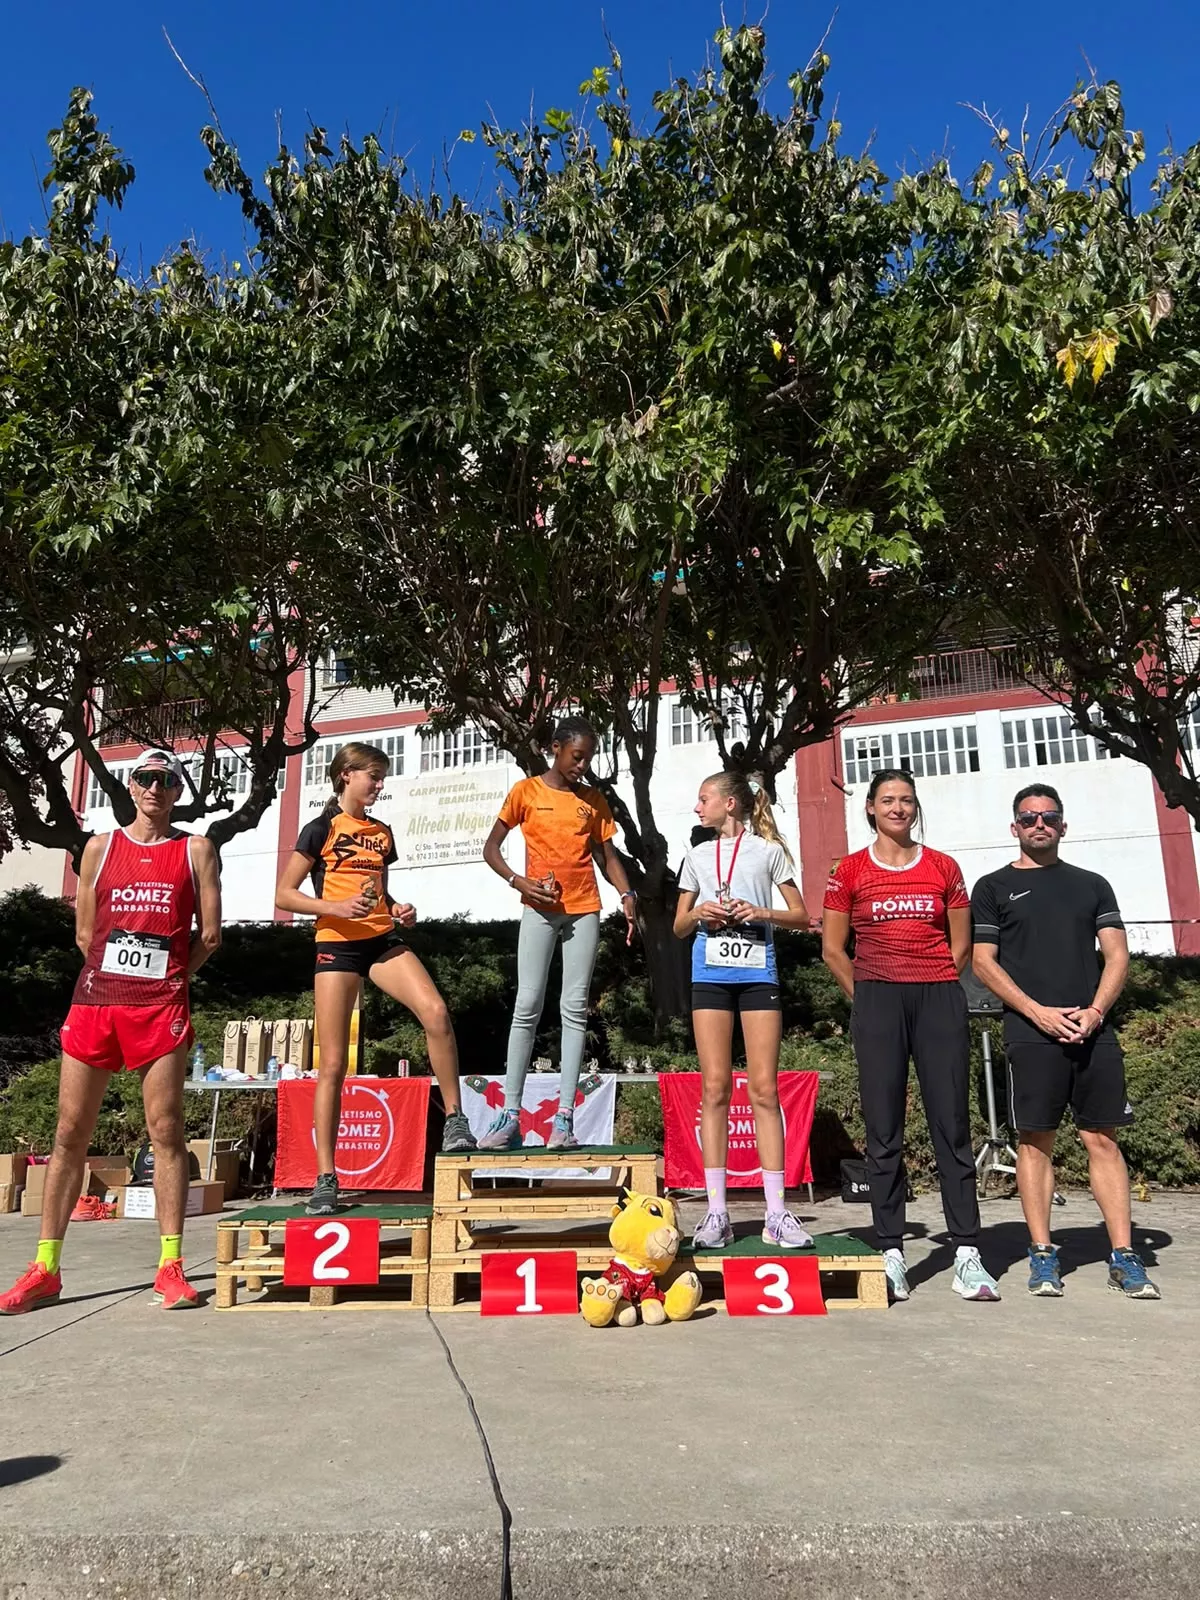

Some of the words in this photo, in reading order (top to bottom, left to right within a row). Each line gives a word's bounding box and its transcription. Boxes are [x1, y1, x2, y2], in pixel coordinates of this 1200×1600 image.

[409, 782, 476, 797] CARPINTERIA
[438, 790, 504, 805] EBANISTERIA
[406, 813, 450, 837] Alfredo
[434, 841, 451, 849] Teresa
[473, 838, 480, 846] 15
[134, 881, 174, 890] ATLETISMO
[111, 885, 173, 904] PÓMEZ
[110, 904, 170, 914] BARBASTRO
[871, 897, 935, 913] PÓMEZ
[719, 942, 753, 959] 307
[117, 949, 152, 969] 001
[340, 1110, 383, 1119] LETISMO
[337, 1120, 382, 1137] ÓMEZ
[336, 1141, 381, 1150] RBASTRO
[313, 1222, 350, 1279] 2
[516, 1257, 543, 1312] 1
[754, 1263, 794, 1313] 3
